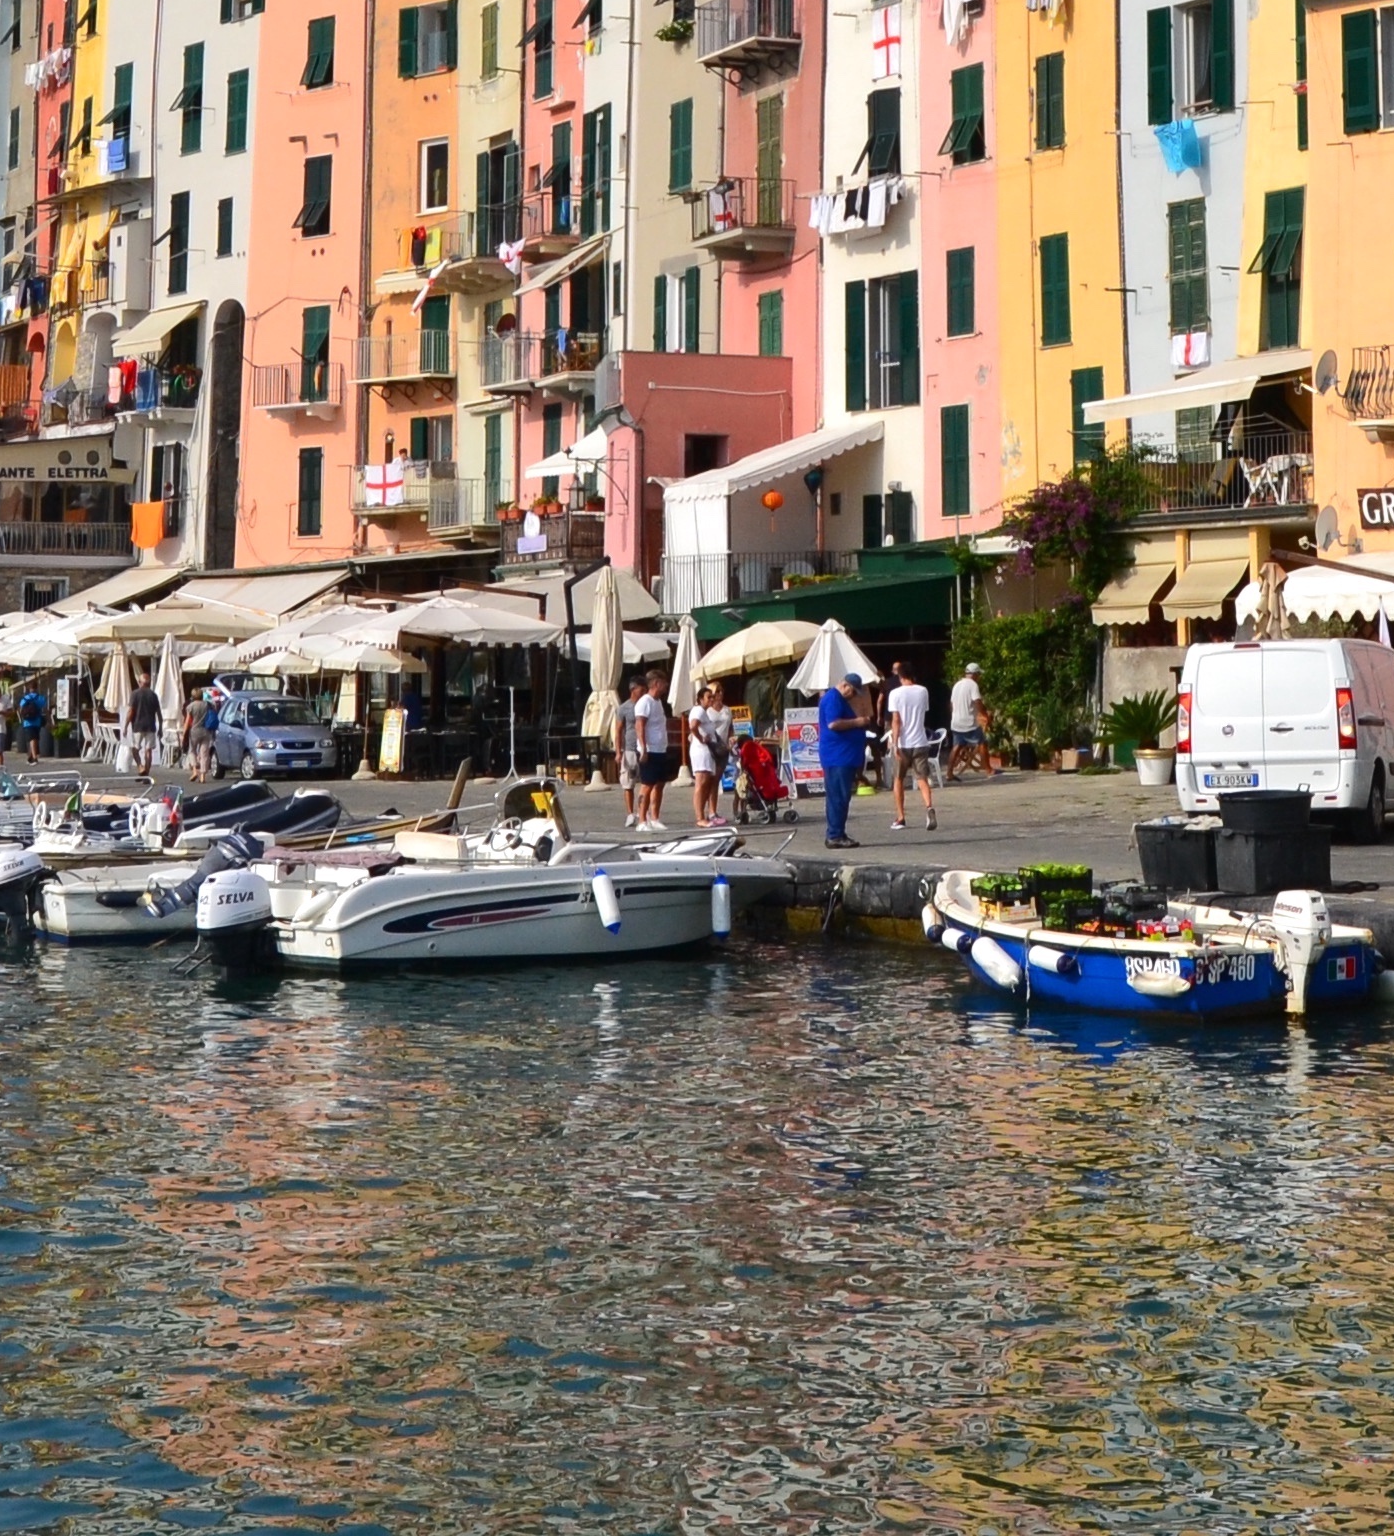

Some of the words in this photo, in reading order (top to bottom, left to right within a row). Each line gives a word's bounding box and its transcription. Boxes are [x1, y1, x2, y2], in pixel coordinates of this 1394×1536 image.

[48, 467, 108, 479] ELETTRA
[217, 891, 255, 905] SELVA
[1228, 954, 1256, 982] 460
